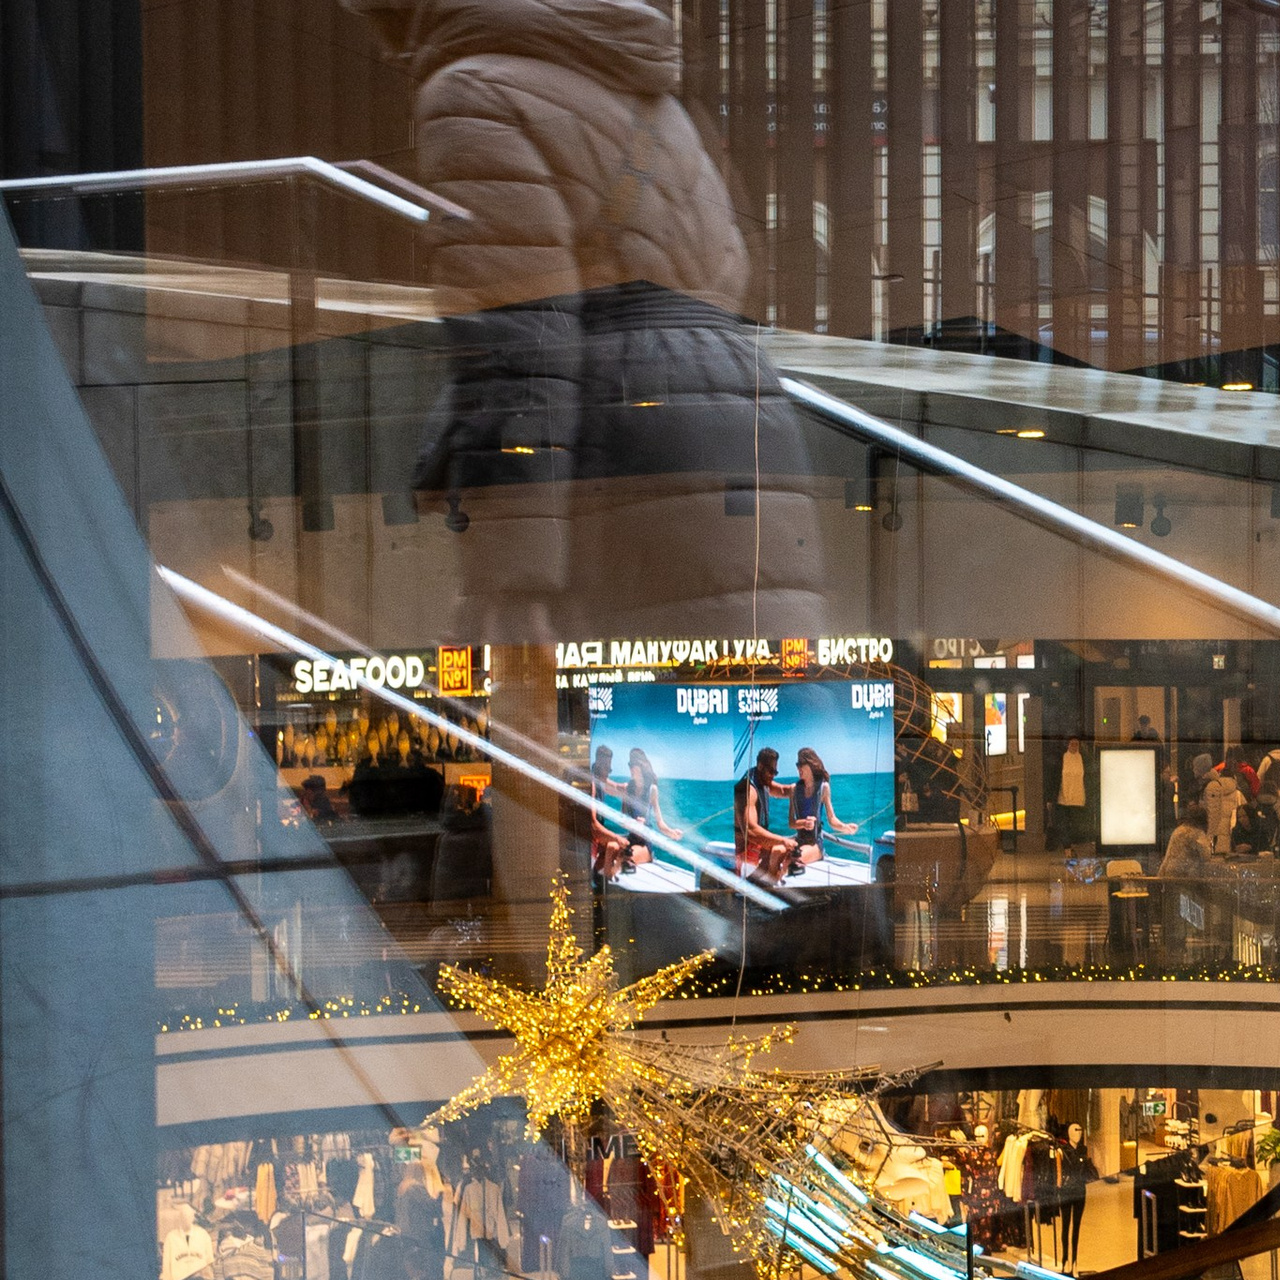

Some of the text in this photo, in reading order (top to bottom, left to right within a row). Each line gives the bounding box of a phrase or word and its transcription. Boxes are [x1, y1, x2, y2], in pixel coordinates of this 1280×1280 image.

[555, 642, 602, 667] НАЯ
[818, 637, 893, 666] БИСТРО
[294, 656, 424, 693] SEAFOOD
[676, 688, 728, 716] DUBAI
[851, 683, 894, 711] DUBA
